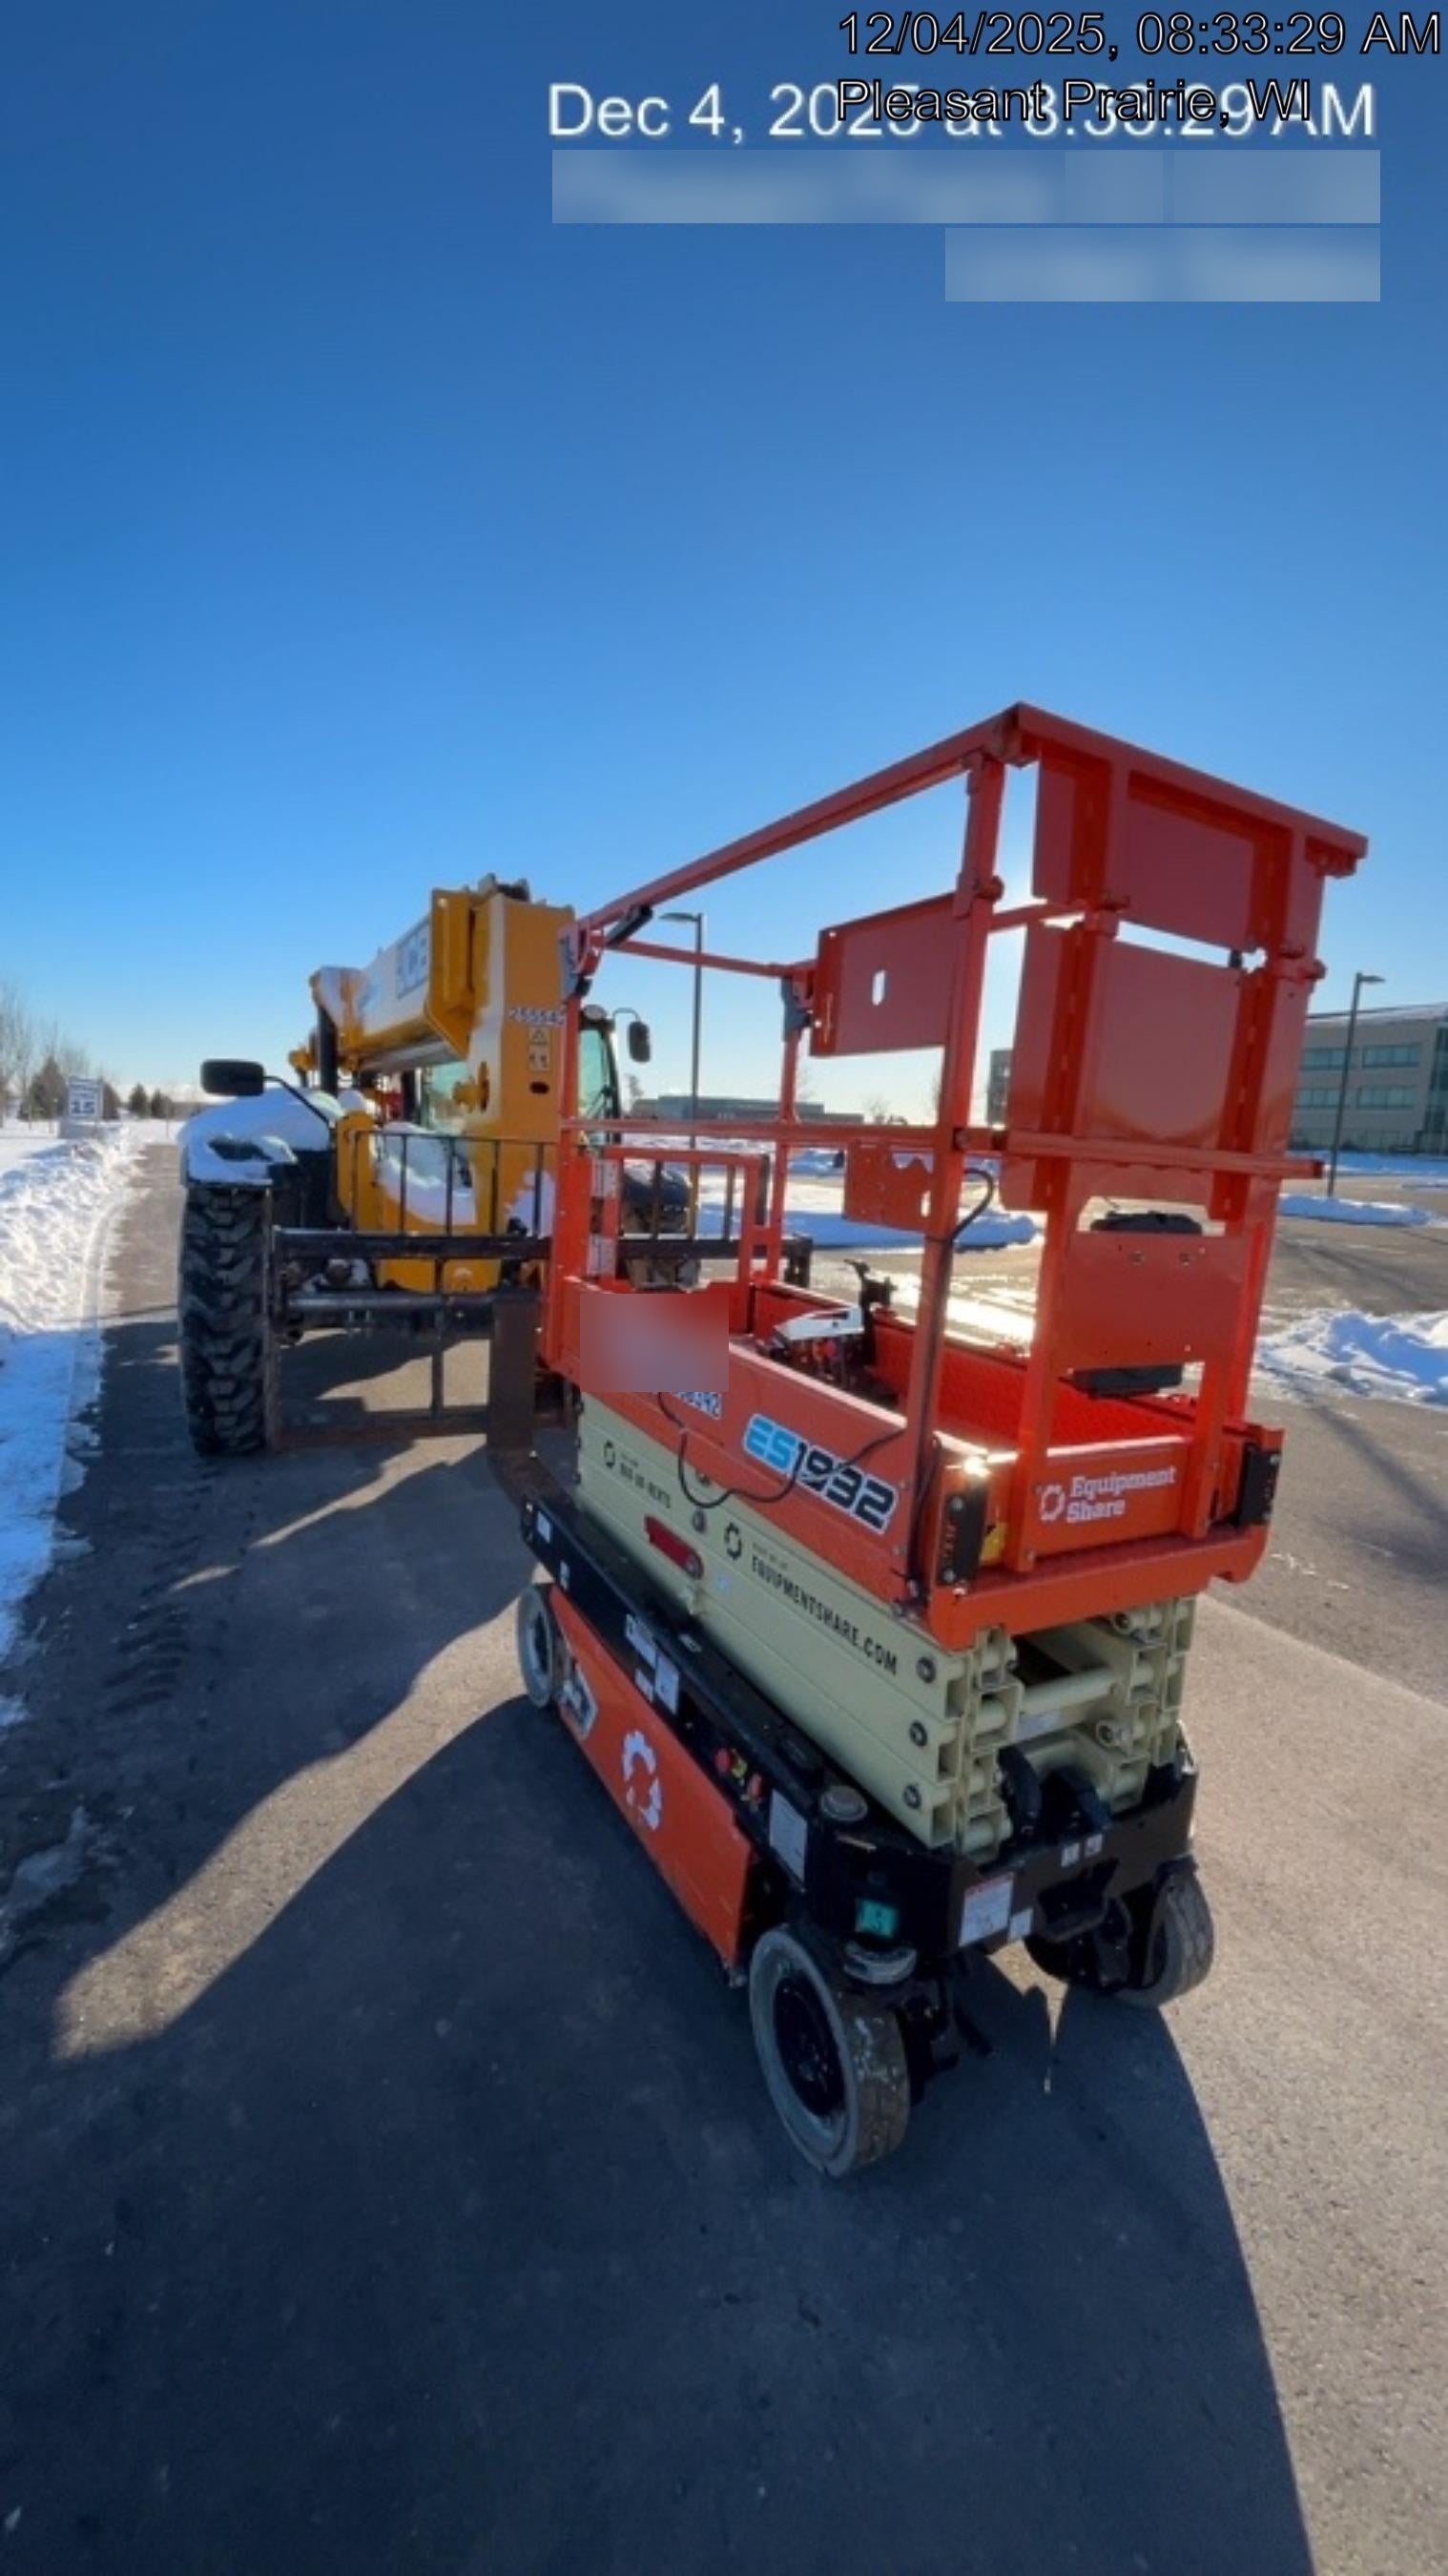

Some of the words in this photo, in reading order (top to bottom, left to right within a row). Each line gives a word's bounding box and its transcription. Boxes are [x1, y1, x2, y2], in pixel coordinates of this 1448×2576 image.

[1070, 1466, 1176, 1499] Equipment
[1066, 1500, 1126, 1524] Share
[752, 1555, 898, 1675] EQUIPMENTSHARE.COM
